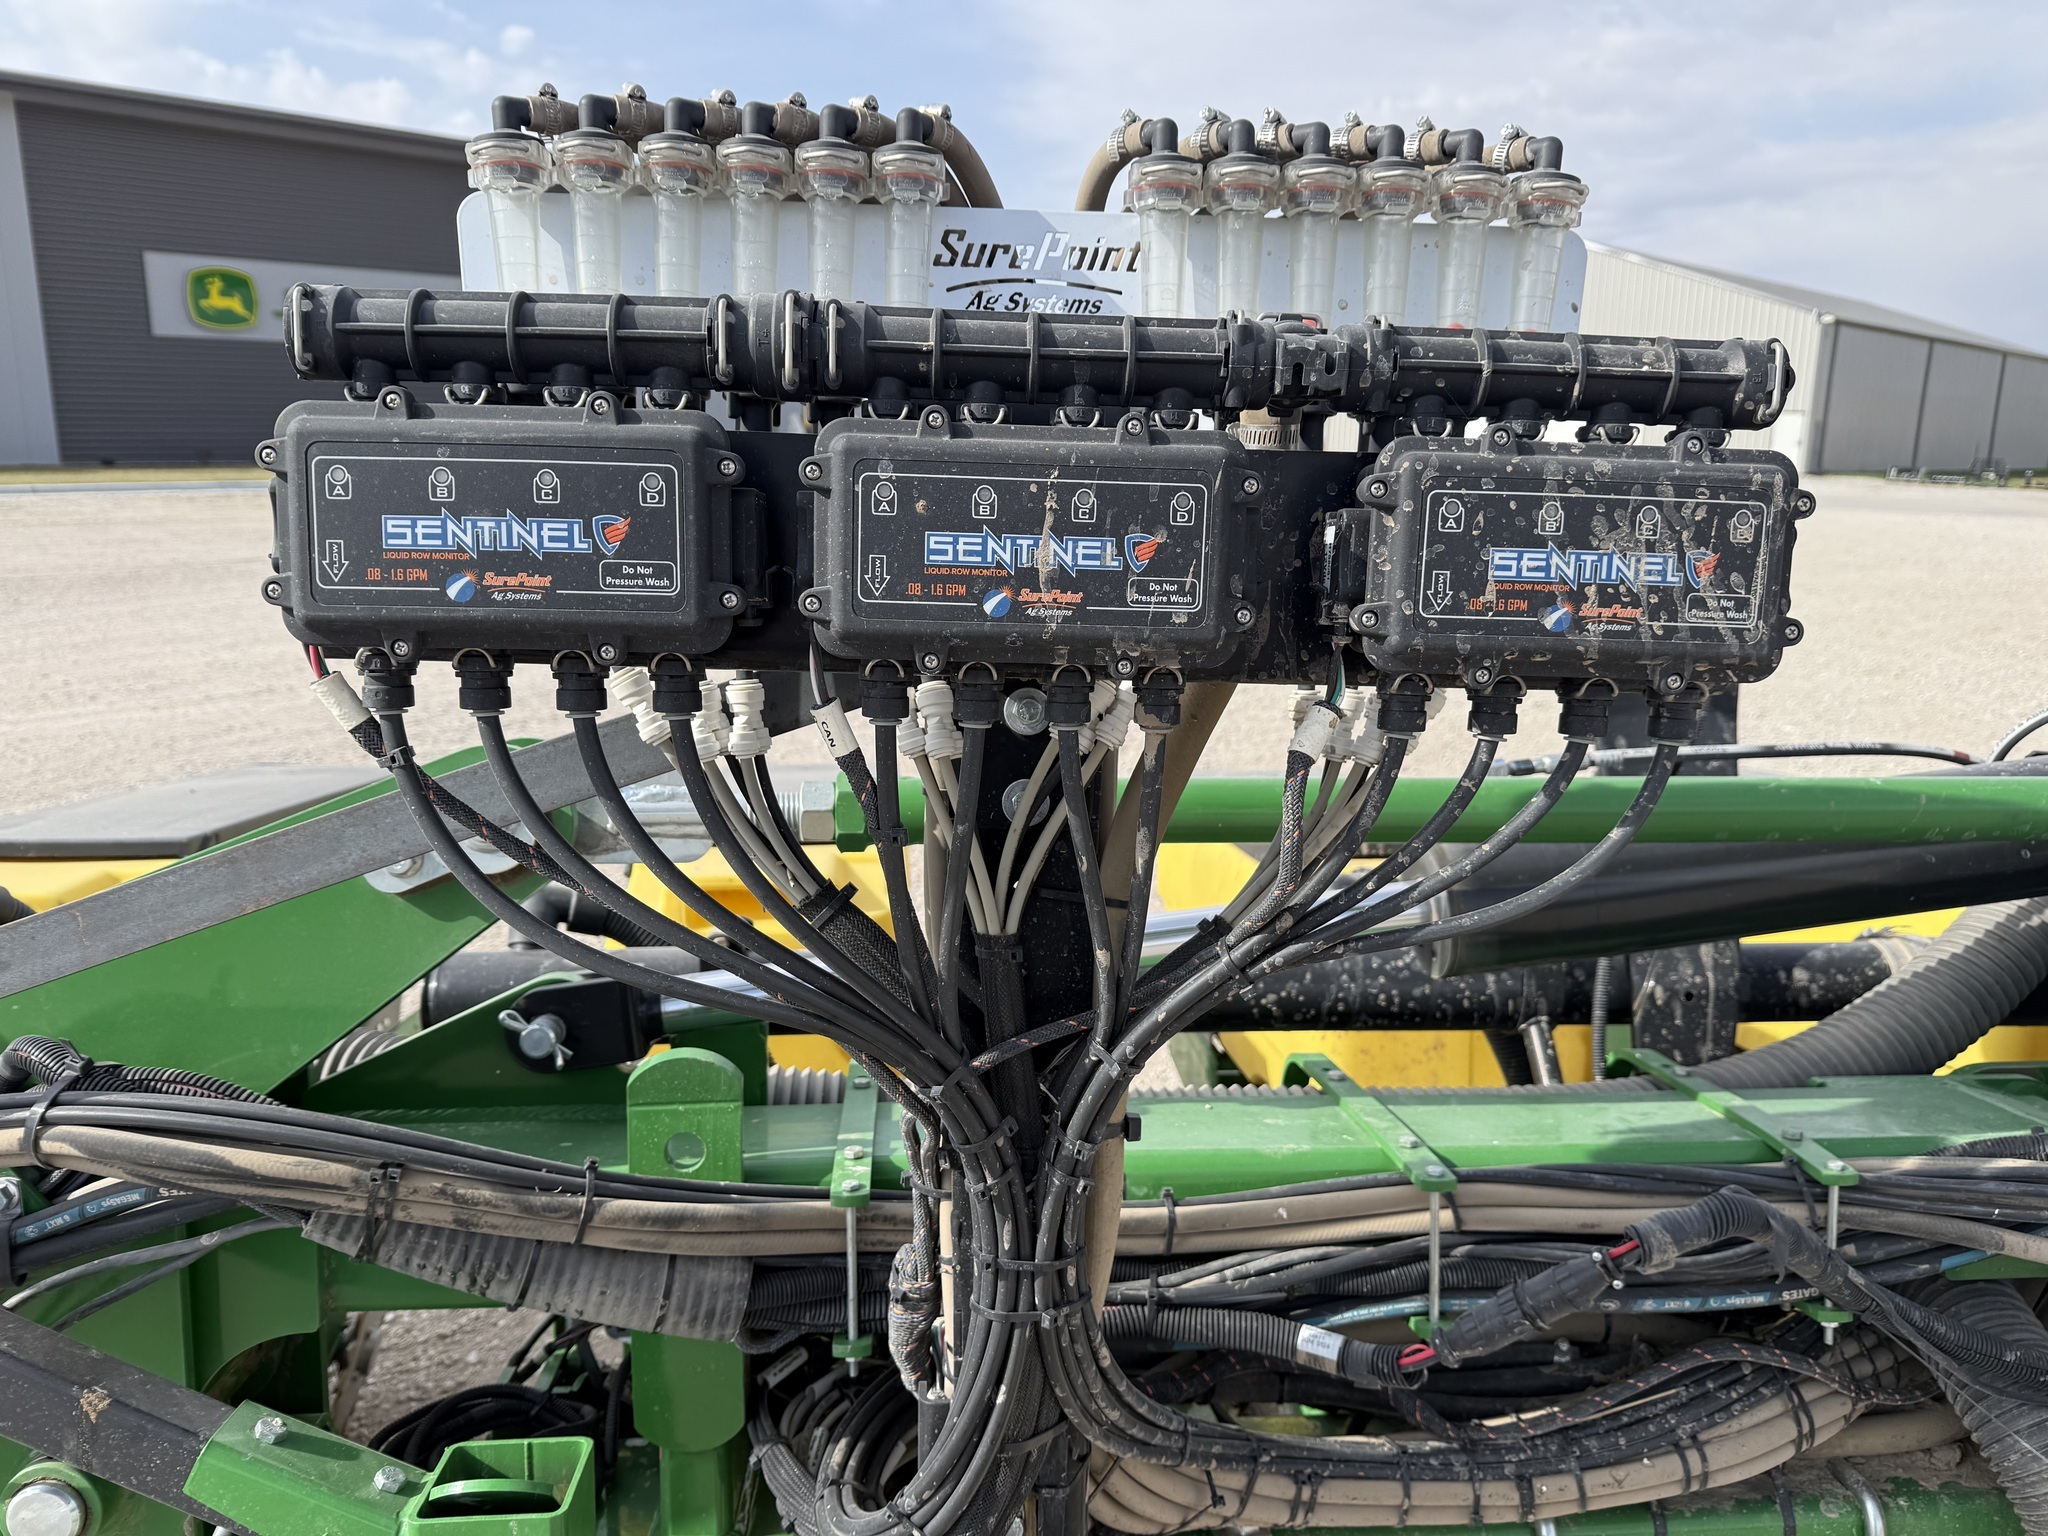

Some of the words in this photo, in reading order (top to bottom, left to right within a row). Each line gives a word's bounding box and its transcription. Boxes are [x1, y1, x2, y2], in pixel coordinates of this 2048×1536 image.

[932, 228, 1141, 272] SurePoint
[965, 290, 1003, 312] Ag
[1004, 292, 1103, 314] Systems
[332, 486, 345, 496] A
[436, 487, 448, 497] B
[541, 490, 553, 500] C
[647, 493, 660, 503] D
[878, 502, 891, 512] A
[979, 505, 991, 515] B
[1079, 508, 1090, 519] C
[1177, 512, 1189, 522] D
[1445, 518, 1457, 528] A
[1546, 522, 1556, 531] B
[385, 516, 590, 553] SENTINEL
[1643, 526, 1653, 535] C
[411, 552, 431, 560] ROW
[432, 552, 470, 560] MONITOR
[928, 534, 1120, 571] SENTNEL
[622, 565, 636, 574] Do
[637, 565, 653, 575] Not
[924, 567, 950, 575] LIQUID
[972, 568, 1008, 576] MONITOR
[1492, 551, 1682, 586] SENTINEL
[365, 567, 381, 580] .08
[391, 568, 404, 581] 1.6
[406, 568, 429, 582] GPM
[482, 571, 552, 587] SurePoint
[606, 576, 643, 586] Pressure
[645, 577, 670, 587] Wash
[905, 583, 921, 595] .08
[931, 583, 943, 595] 1.6
[946, 584, 967, 596] GPM
[1150, 583, 1161, 591] Do
[1163, 583, 1178, 591] Not
[1515, 583, 1533, 591] ROW
[1534, 583, 1570, 592] MONITOR
[491, 591, 505, 601] Ag
[505, 592, 542, 601] Systems
[1018, 588, 1083, 602] SurePoint
[1133, 594, 1169, 603] Pressure
[1170, 594, 1192, 603] Wash
[1507, 599, 1528, 612] GPM
[1708, 599, 1718, 607] Do
[1720, 599, 1735, 607] Not
[1025, 607, 1037, 616] Ag
[1038, 608, 1073, 618] Systems
[1579, 603, 1643, 618] SurePoint
[1691, 609, 1724, 618] Pressure
[1726, 610, 1748, 619] Wash
[1598, 623, 1632, 632] Systems
[821, 721, 837, 747] CAN
[101, 1193, 141, 1208] MEGASys
[46, 1216, 64, 1229] MXT
[63, 1214, 71, 1223] 6
[1781, 1287, 1820, 1301] GATES
